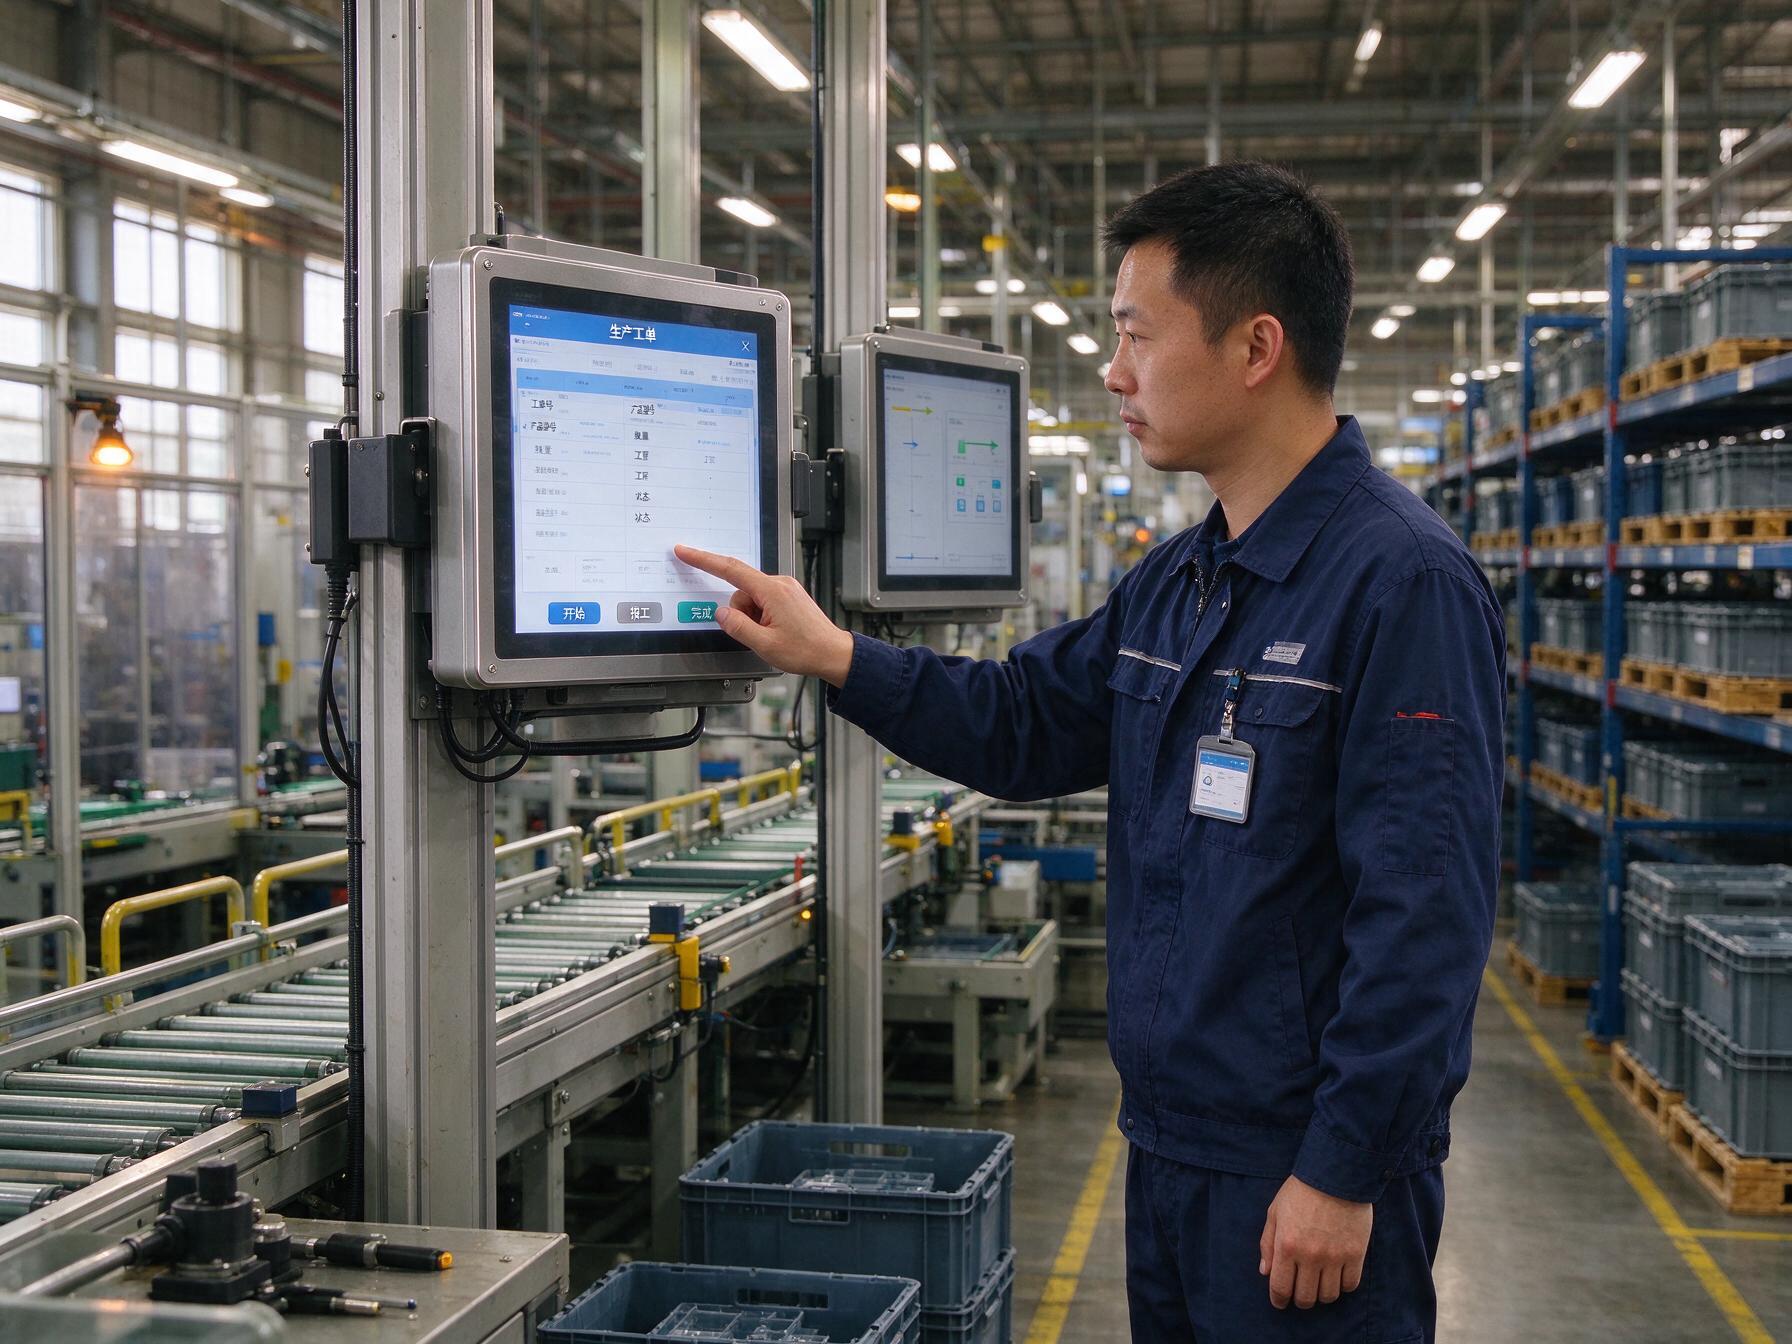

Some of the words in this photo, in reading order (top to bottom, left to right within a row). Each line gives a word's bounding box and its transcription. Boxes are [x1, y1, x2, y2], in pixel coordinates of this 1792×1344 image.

[609, 323, 657, 343] 生产工单
[562, 606, 585, 621] 开始
[690, 607, 713, 621] 完成
